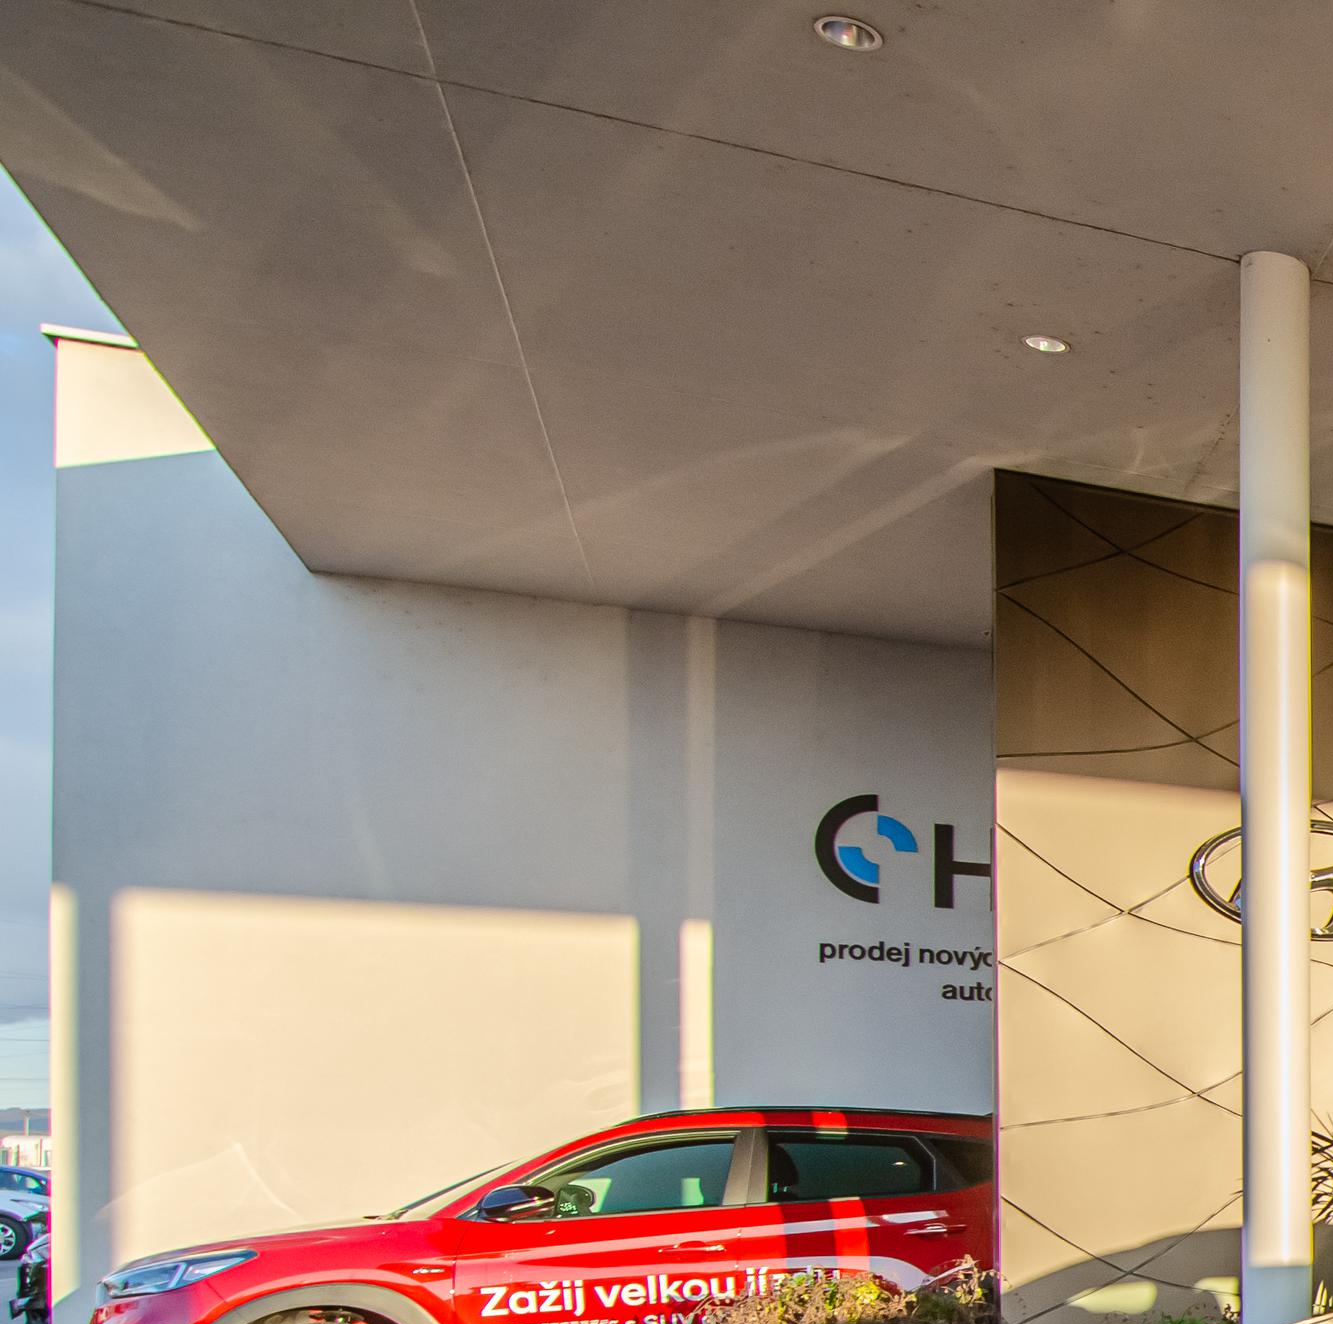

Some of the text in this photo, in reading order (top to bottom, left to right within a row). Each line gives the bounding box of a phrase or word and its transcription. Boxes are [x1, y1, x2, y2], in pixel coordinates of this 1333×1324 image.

[819, 941, 910, 967] prodej
[480, 1280, 585, 1317] Zažij
[594, 1274, 735, 1308] velkou
